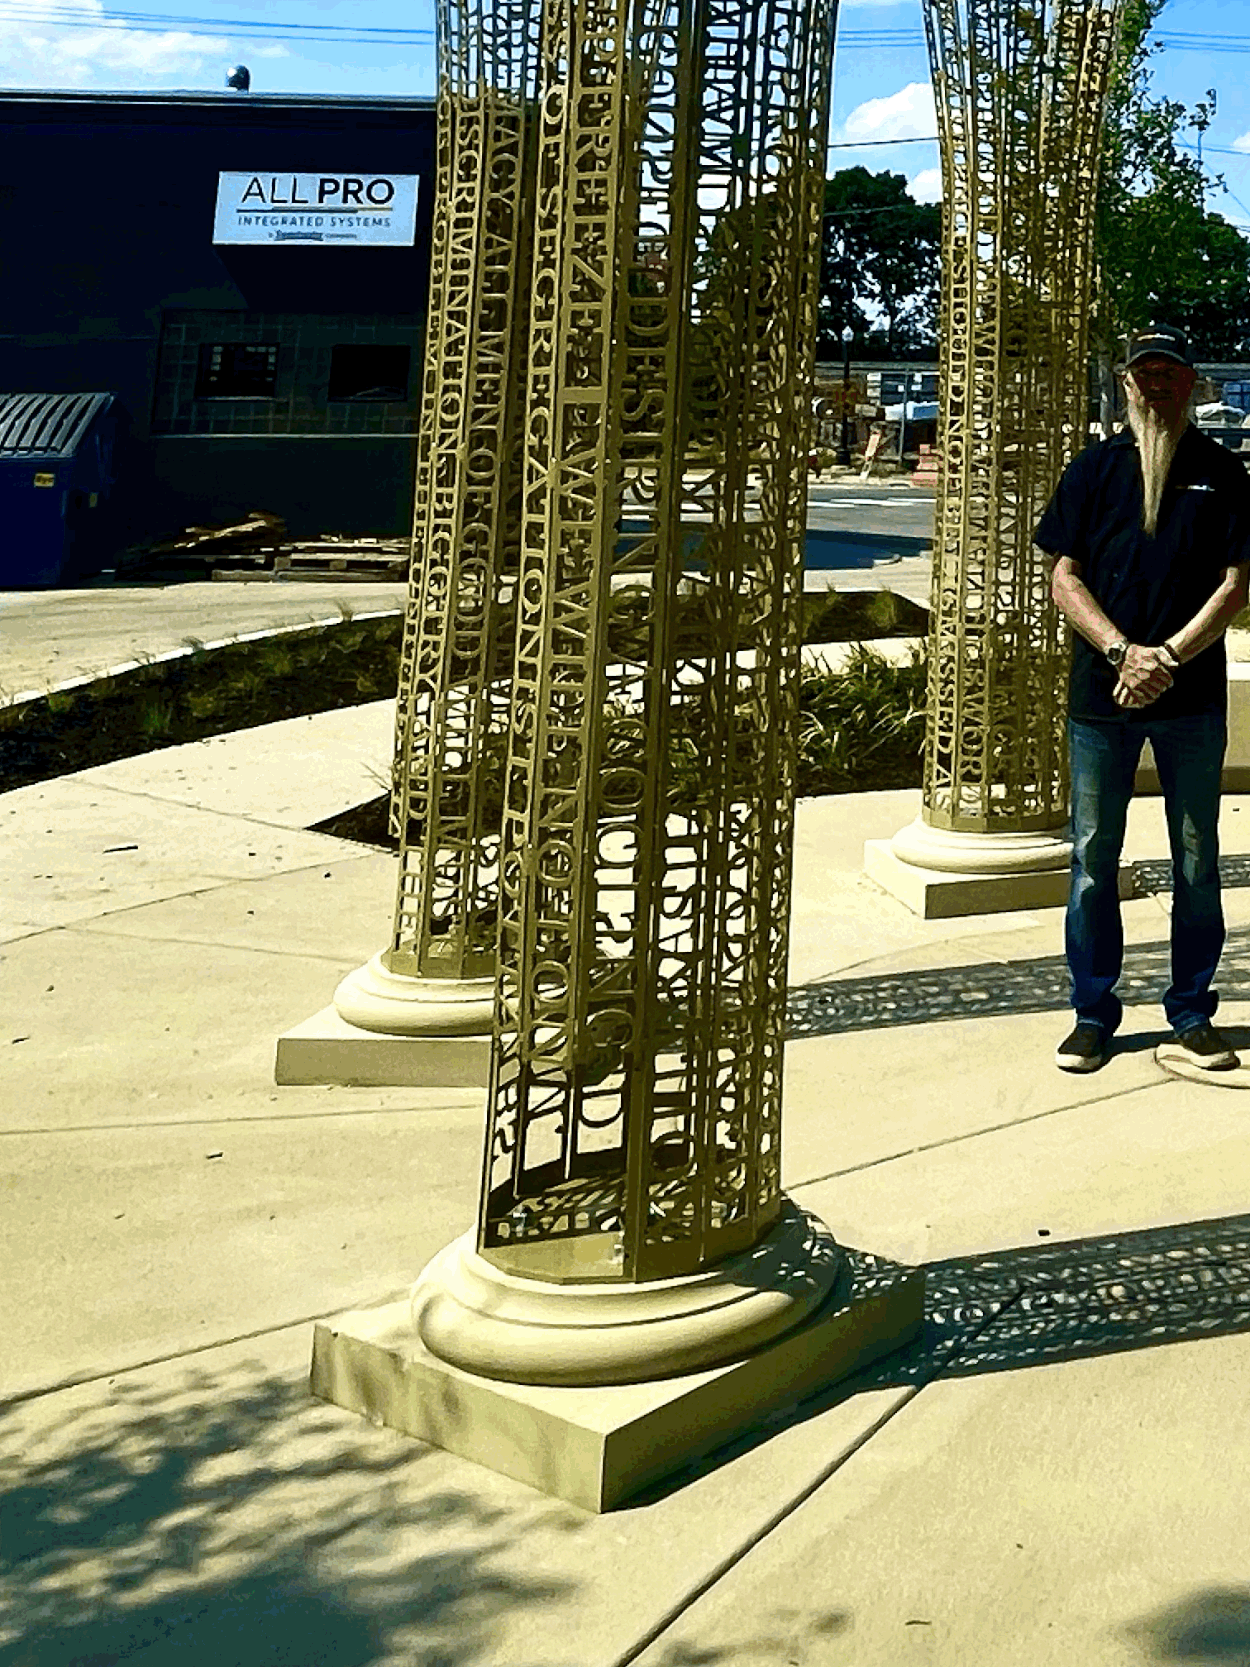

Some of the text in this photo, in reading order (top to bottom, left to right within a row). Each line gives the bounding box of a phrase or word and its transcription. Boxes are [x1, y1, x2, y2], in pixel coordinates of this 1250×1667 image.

[239, 216, 390, 227] INTEGRATED SYSTEMS
[242, 177, 394, 204] ALL PRO
[464, 324, 510, 433] MEN
[458, 444, 501, 514] OF
[409, 482, 455, 699] BIGOTRY
